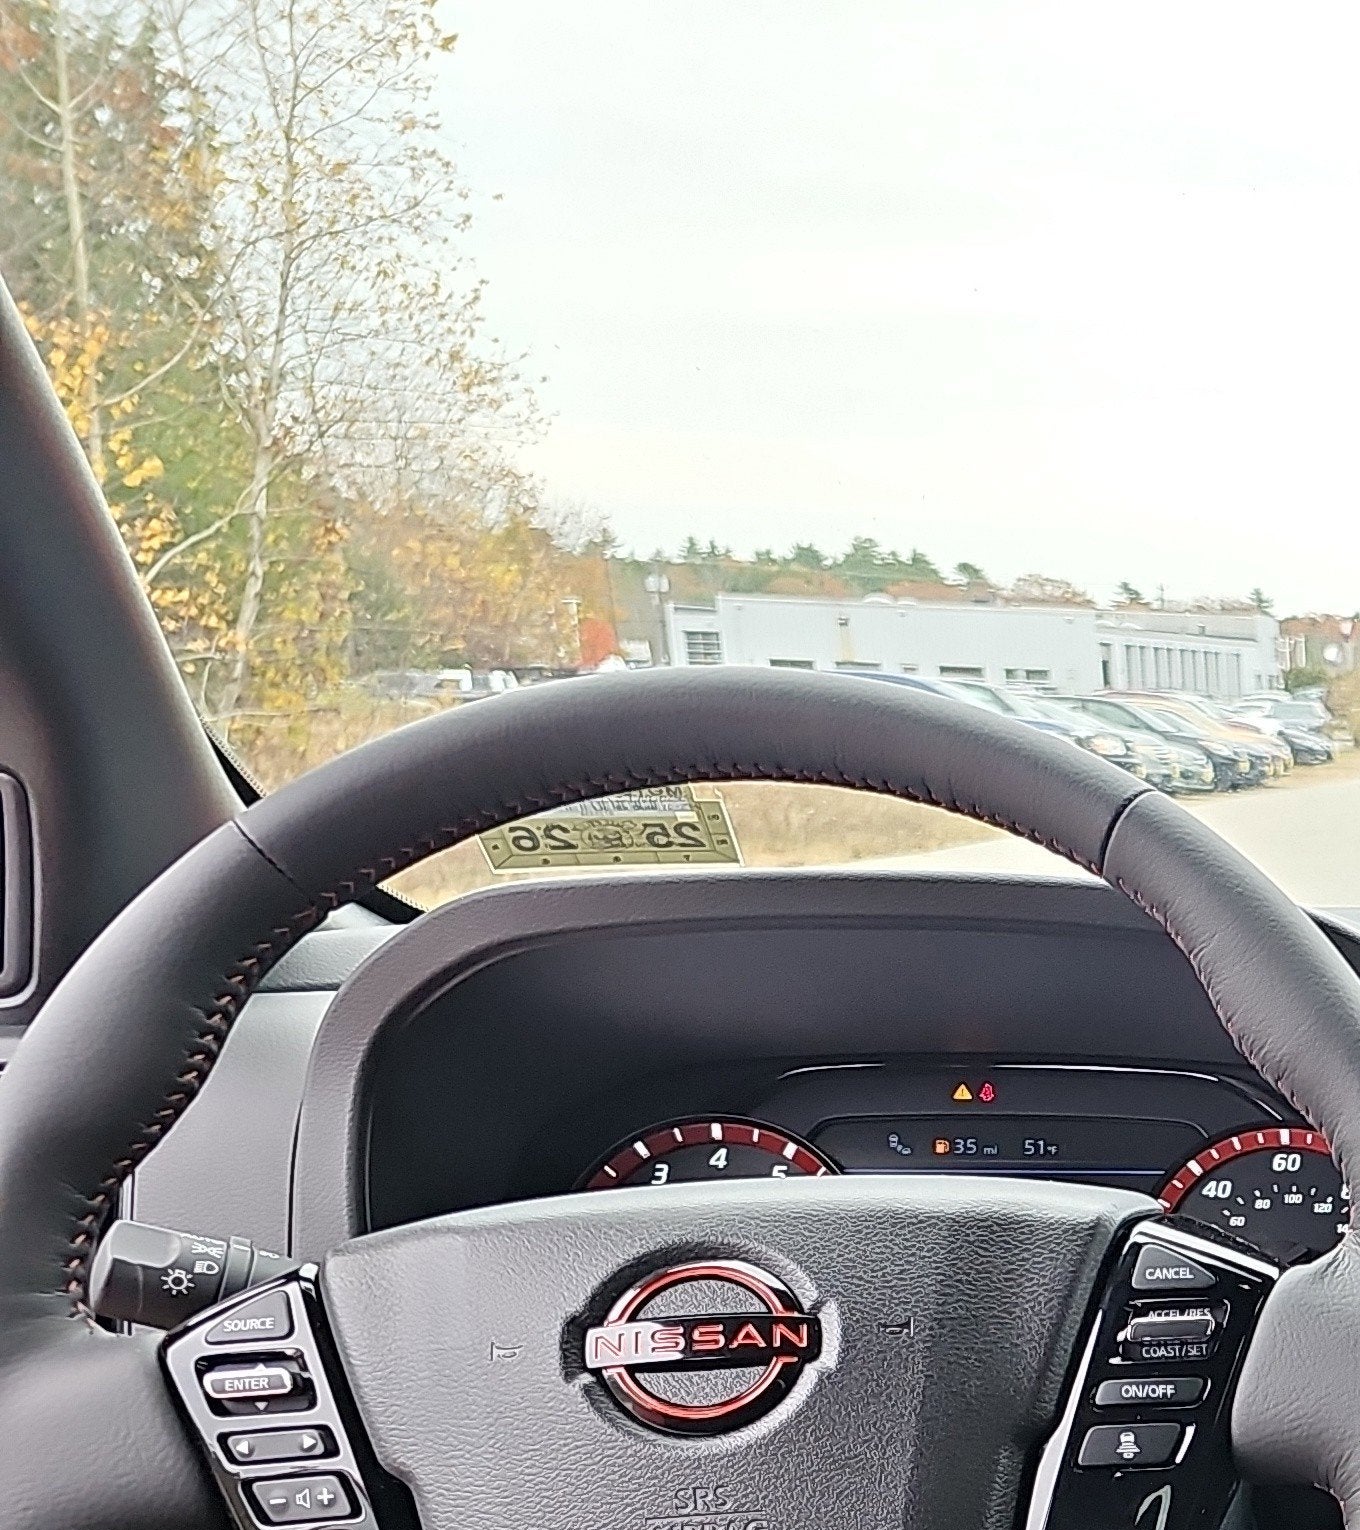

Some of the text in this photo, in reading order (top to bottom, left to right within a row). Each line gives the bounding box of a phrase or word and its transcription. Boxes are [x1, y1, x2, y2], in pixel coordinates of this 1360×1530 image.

[953, 1139, 977, 1154] 35
[708, 1147, 729, 1169] 4
[1272, 1153, 1301, 1171] 60
[651, 1163, 670, 1185] 3
[1202, 1180, 1232, 1198] 40
[1145, 1267, 1194, 1280] CANCEL
[223, 1317, 275, 1332] SOURCE
[594, 1323, 808, 1361] NISSAN
[1142, 1344, 1208, 1358] COAST/SET
[224, 1377, 269, 1391] ENTER
[1121, 1384, 1176, 1398] ON/OFF
[674, 1485, 733, 1514] SRS
